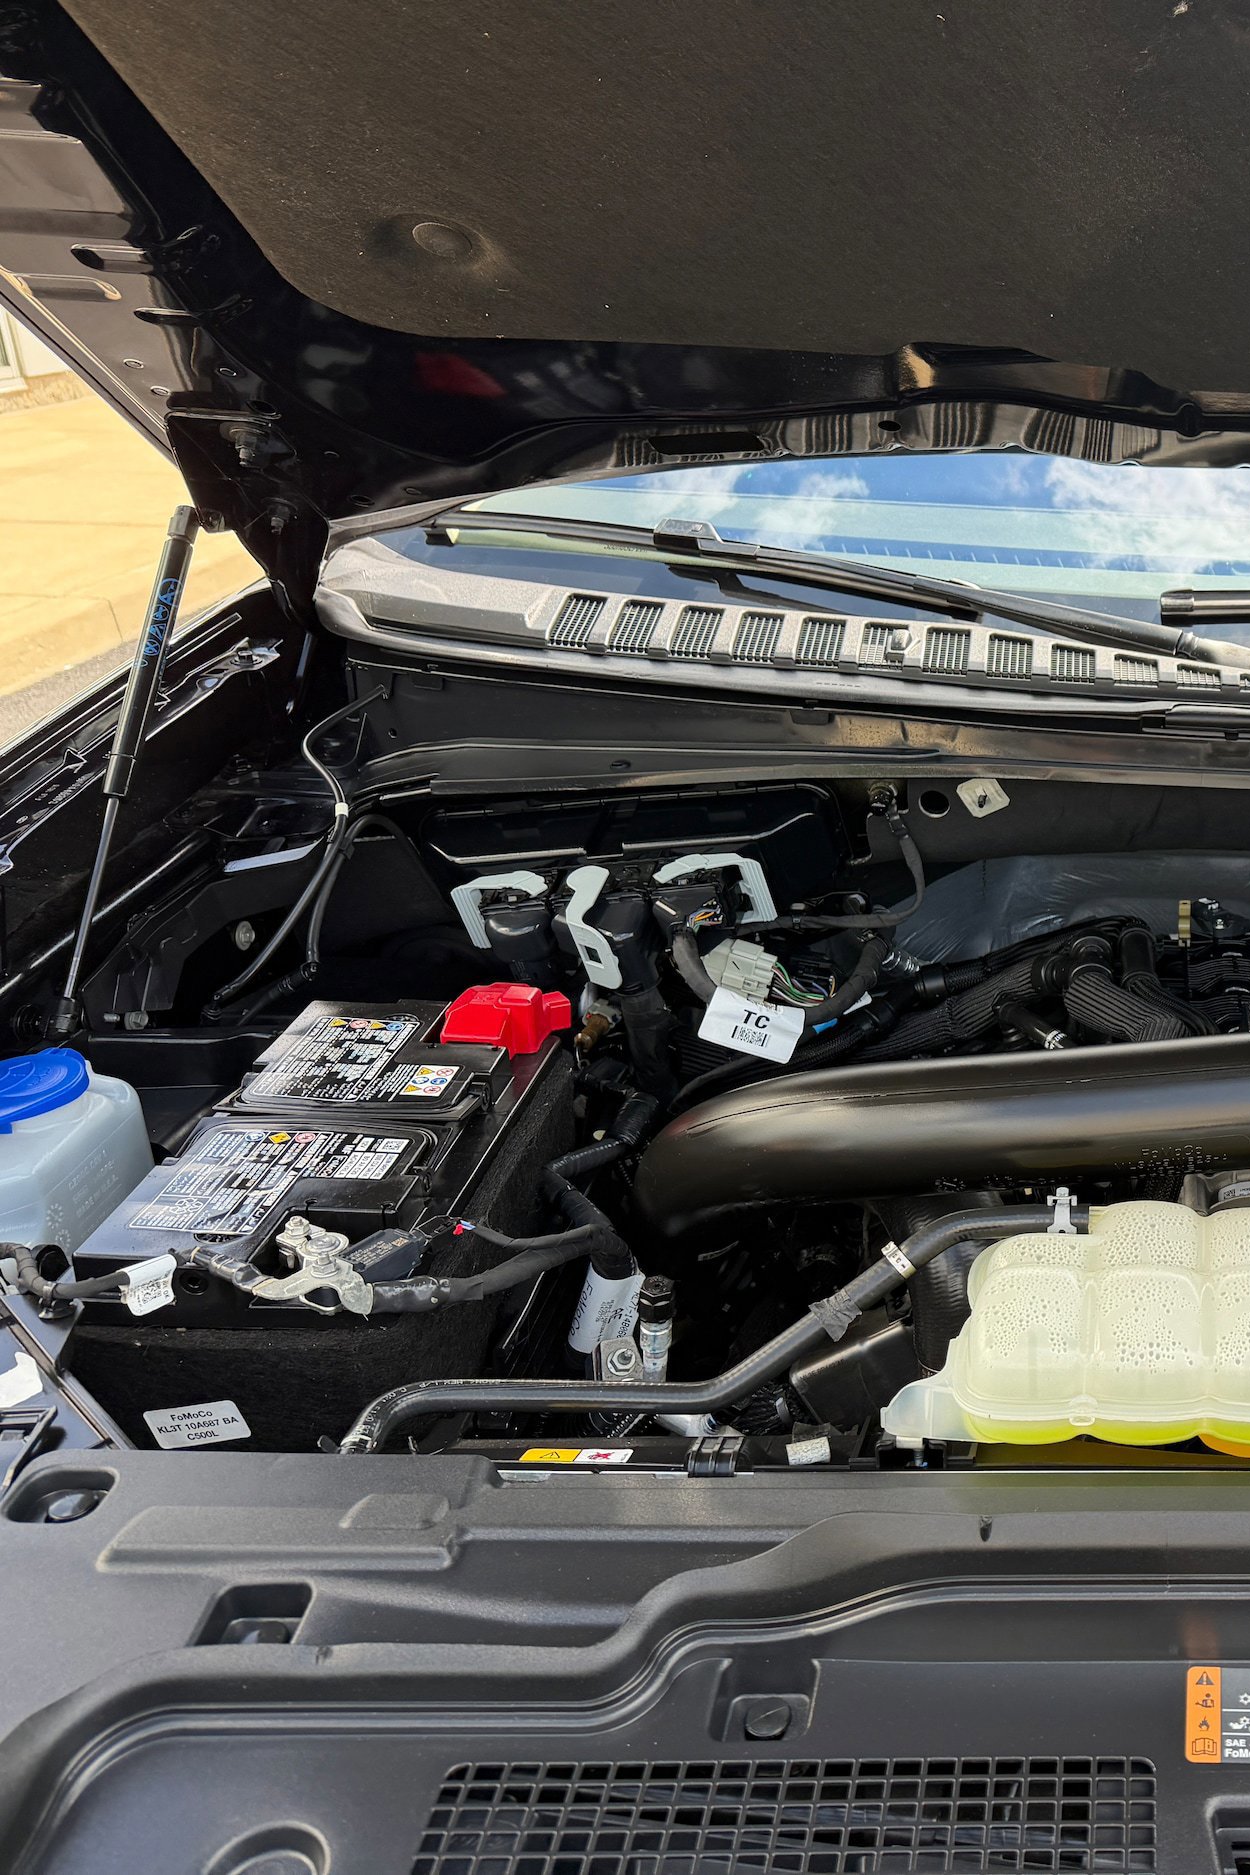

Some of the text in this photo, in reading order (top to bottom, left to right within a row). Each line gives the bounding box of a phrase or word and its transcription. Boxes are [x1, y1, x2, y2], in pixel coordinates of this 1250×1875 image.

[744, 1009, 770, 1029] TC
[570, 1280, 593, 1336] FoMoCo
[170, 1410, 213, 1422] FoMoCo
[157, 1416, 239, 1434] KL3T 10A687 BA
[187, 1430, 220, 1441] C500L
[1225, 1739, 1247, 1748] SAE
